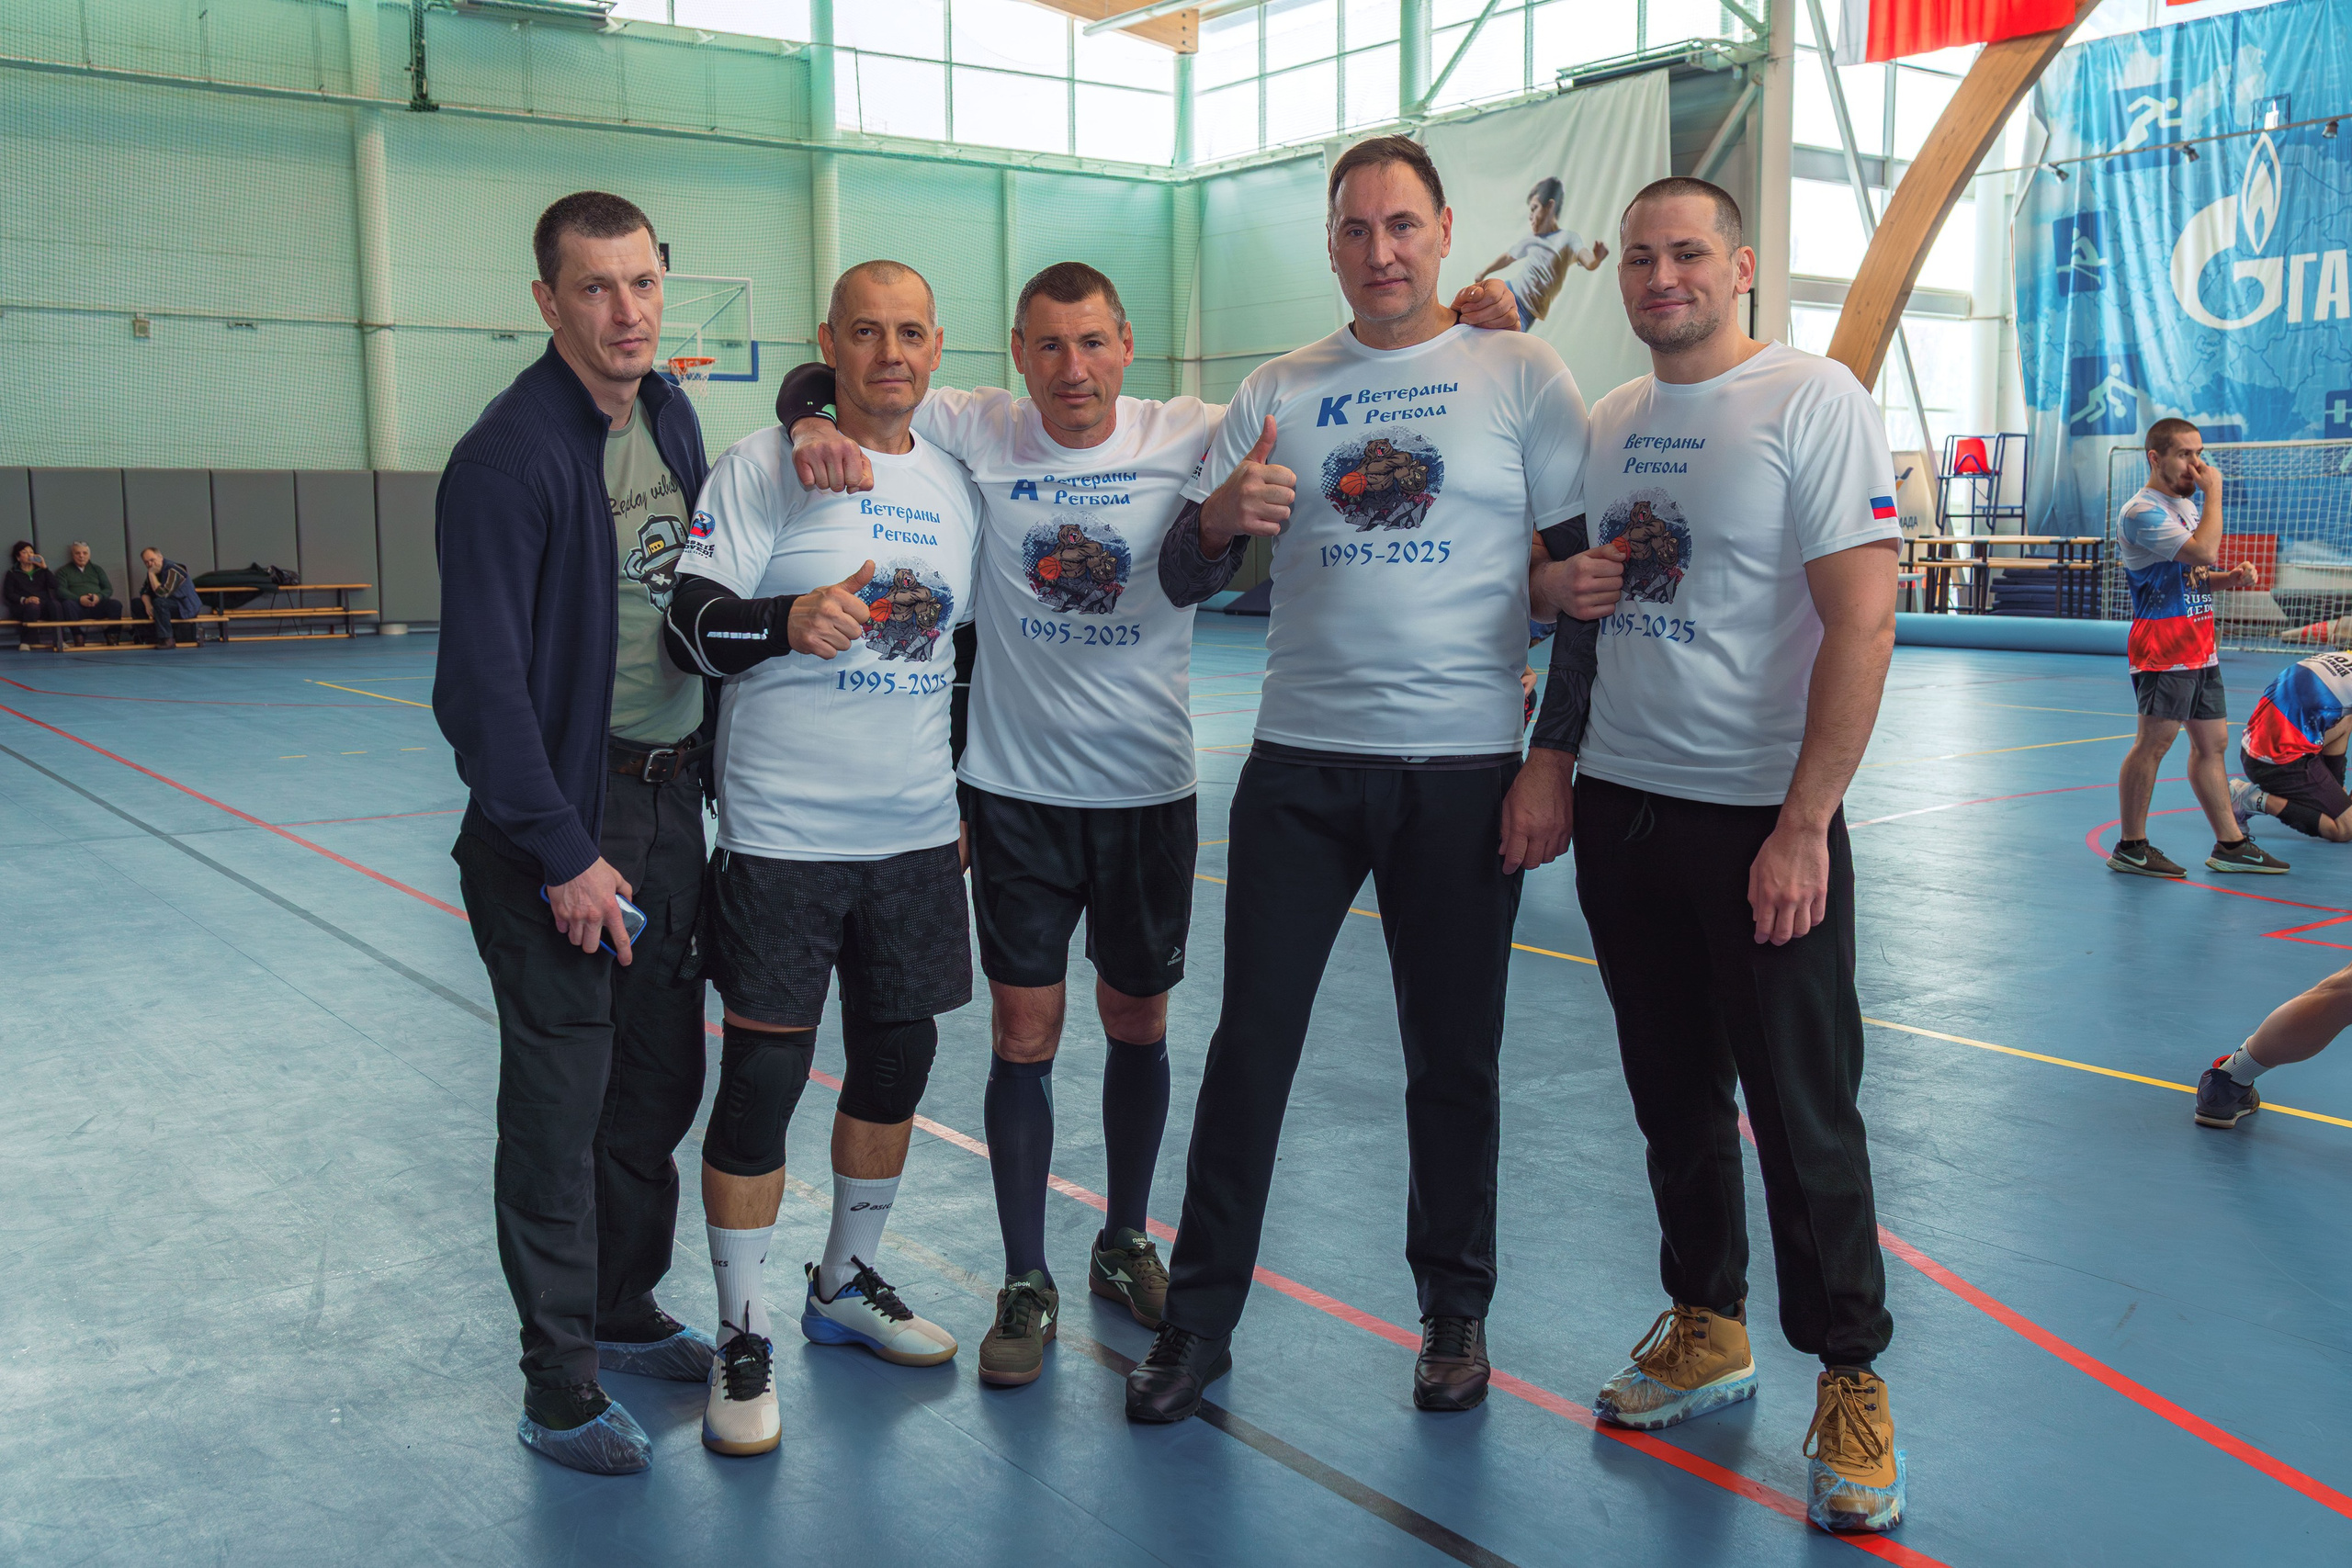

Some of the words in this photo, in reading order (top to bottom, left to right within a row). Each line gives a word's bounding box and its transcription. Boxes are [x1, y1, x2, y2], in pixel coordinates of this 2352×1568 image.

[1355, 382, 1459, 404] Ветераны
[1363, 405, 1447, 424] Регбола
[1623, 434, 1706, 454] Ветераны
[1623, 457, 1688, 474] Регбола
[1053, 490, 1131, 505] Регбола
[860, 499, 941, 524] Ветераны
[872, 523, 938, 546] Регбола
[1320, 540, 1452, 567] 1995-2025
[1020, 617, 1141, 646] 1995-2025
